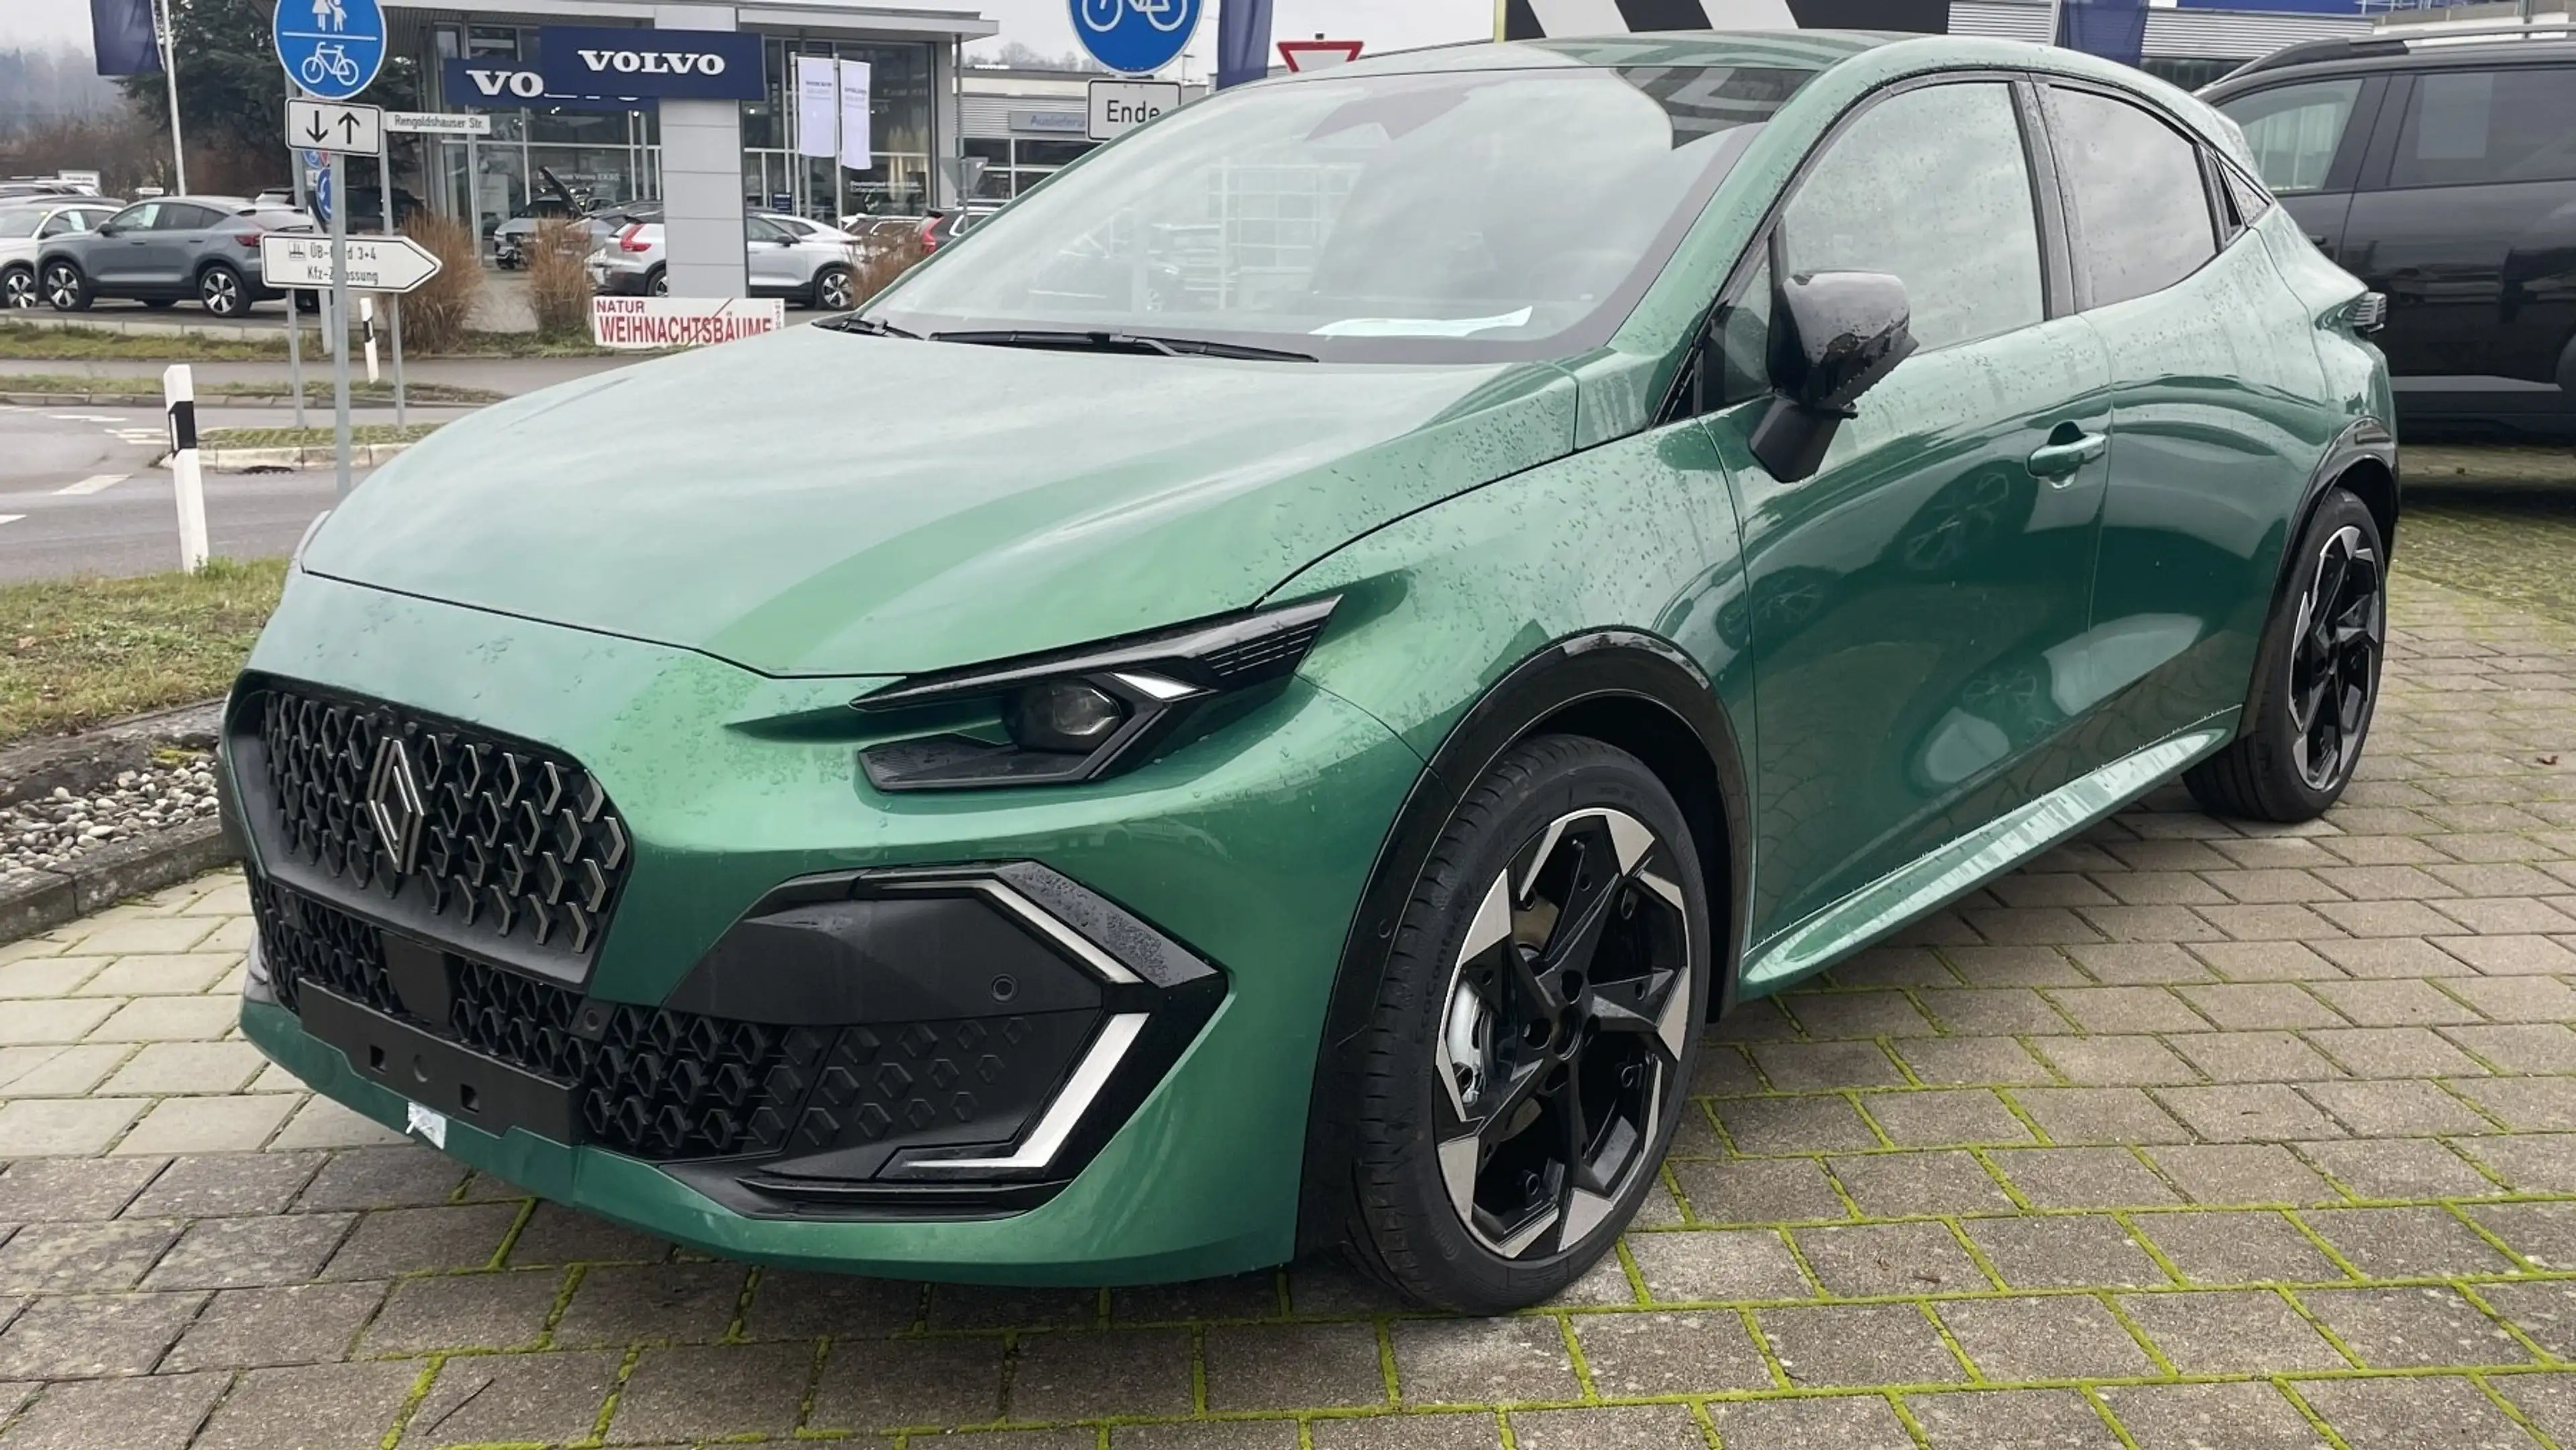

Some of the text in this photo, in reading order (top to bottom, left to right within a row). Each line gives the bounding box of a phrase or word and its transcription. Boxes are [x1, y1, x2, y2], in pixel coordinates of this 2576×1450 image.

[577, 50, 725, 76] VOLVO
[1107, 99, 1160, 123] Ende
[470, 117, 484, 129] Str.
[1030, 115, 1085, 127] Auslieferu
[596, 300, 645, 313] NATUR
[600, 311, 771, 344] WEIHNACHTSBÄUME
